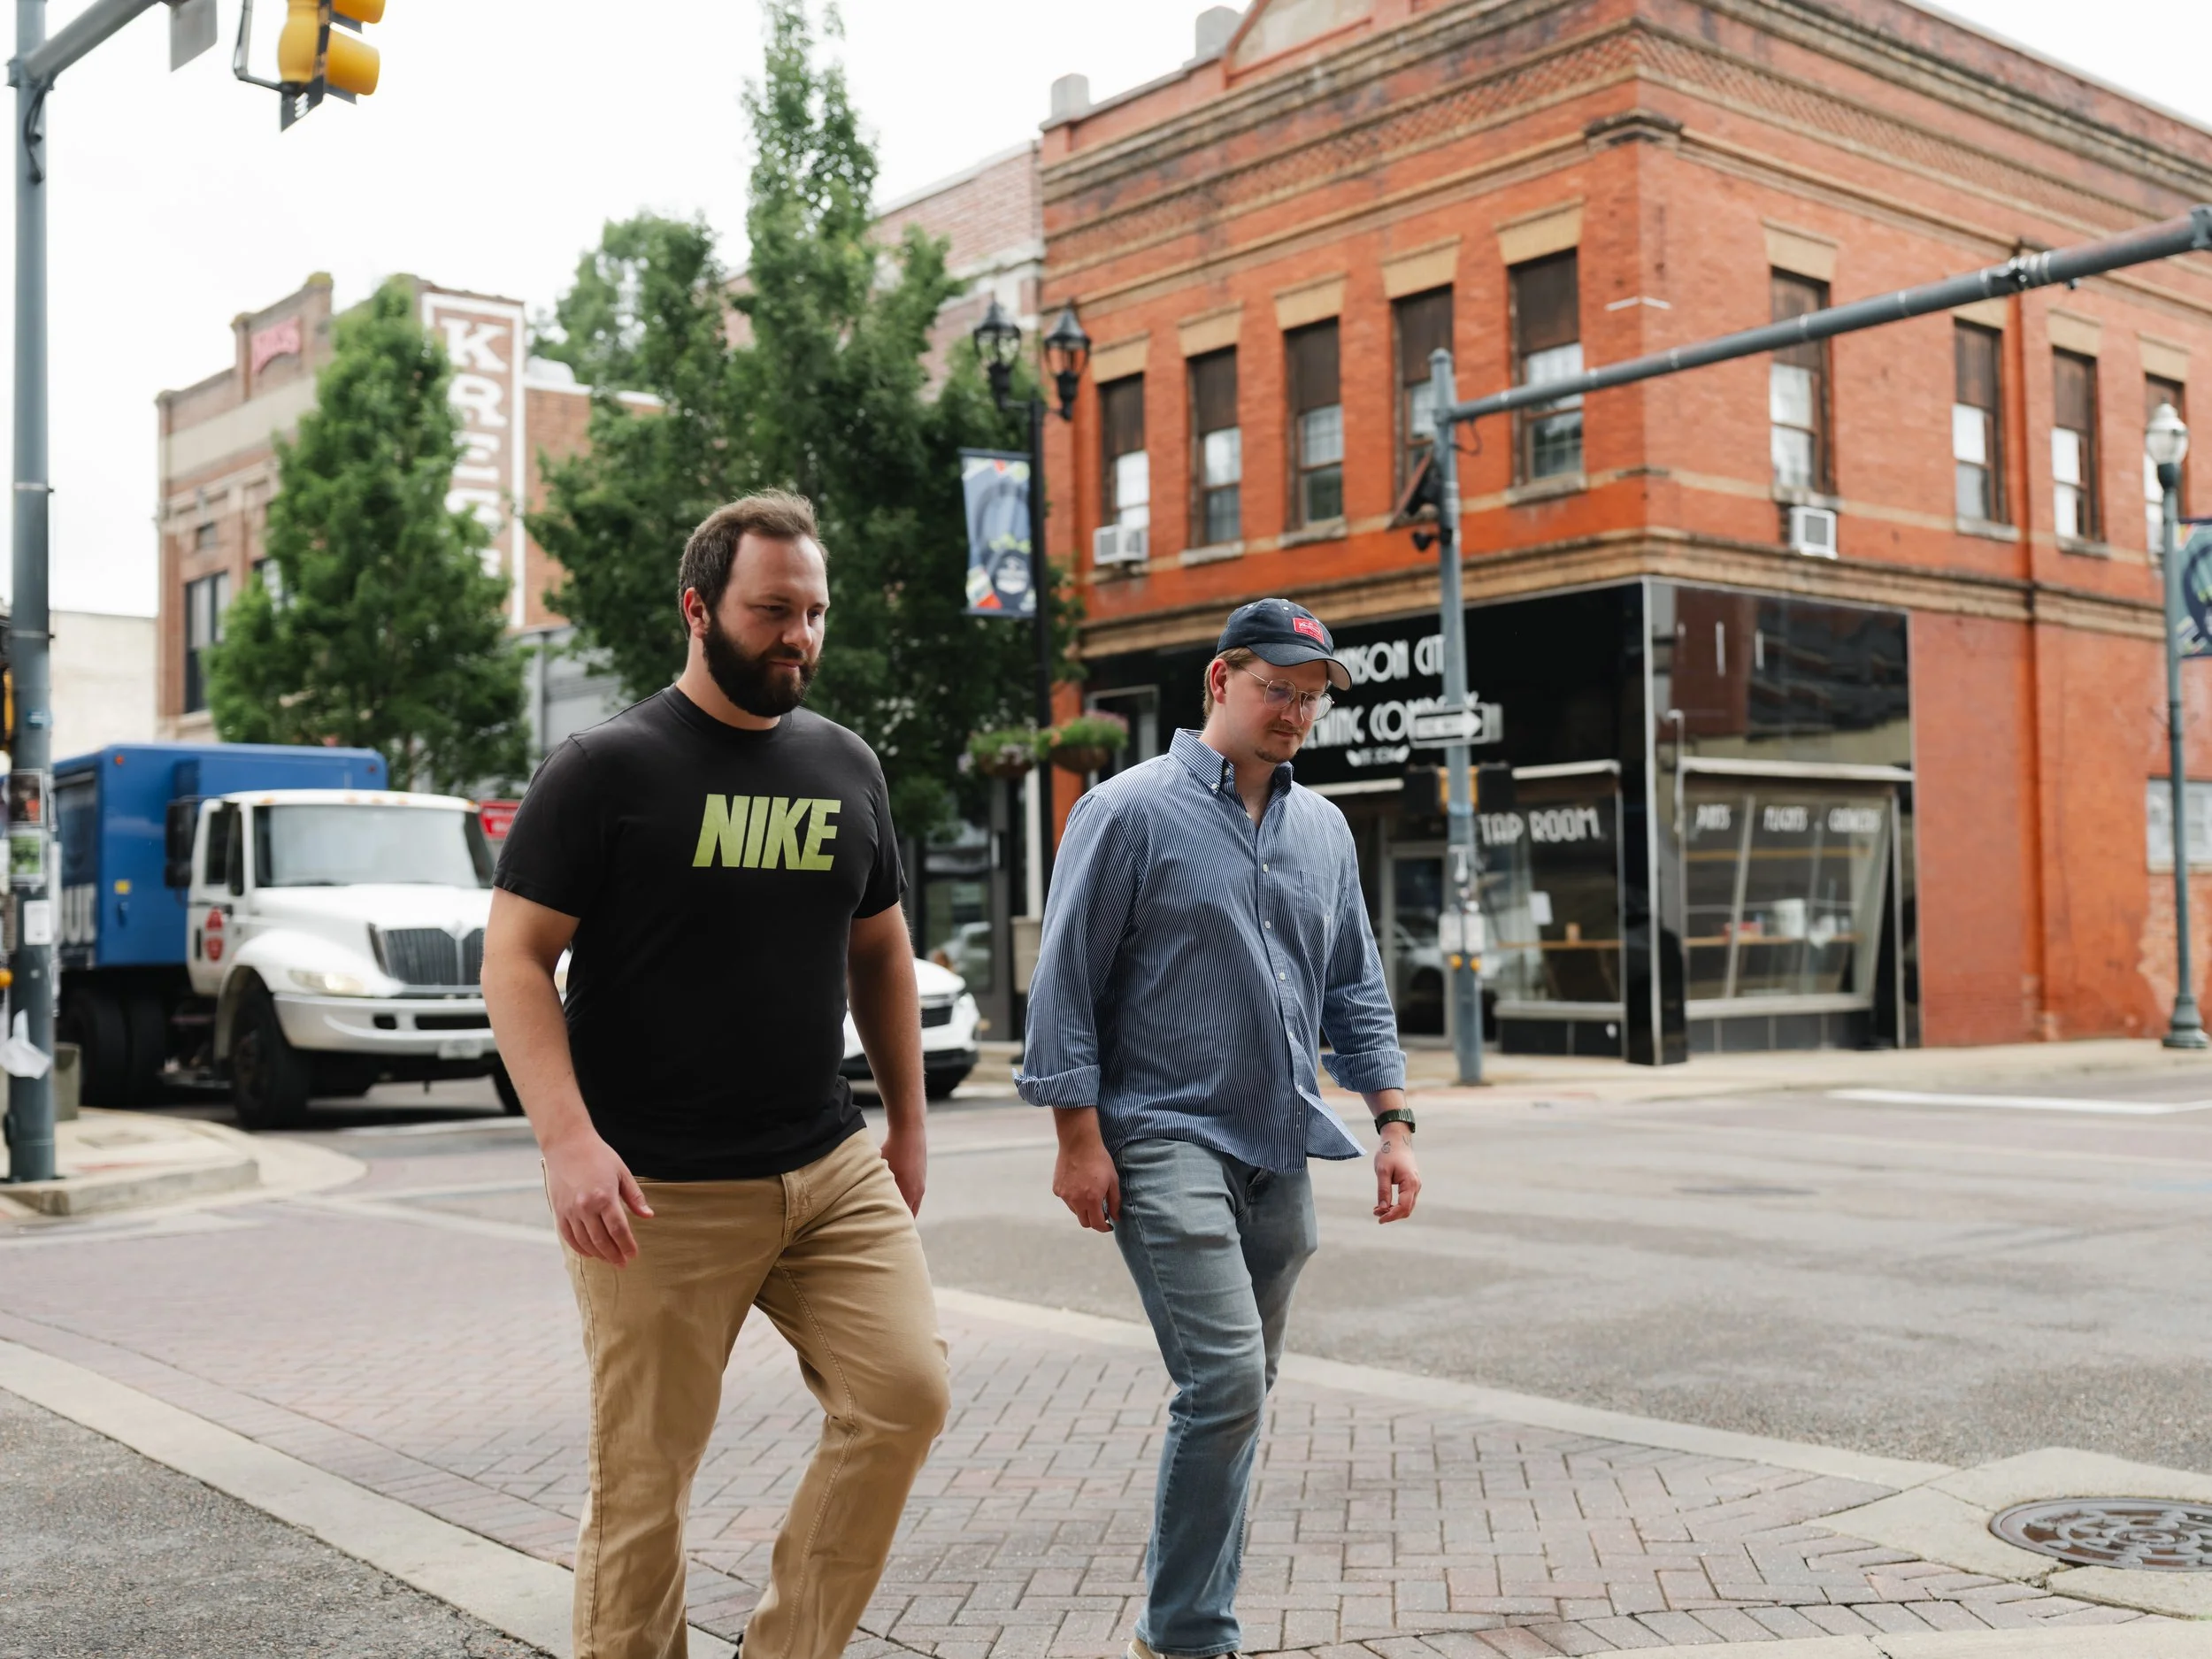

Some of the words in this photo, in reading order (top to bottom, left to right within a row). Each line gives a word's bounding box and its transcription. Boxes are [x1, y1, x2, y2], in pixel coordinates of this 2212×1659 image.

[692, 794, 841, 871] NIKE
[1479, 812, 1525, 846] TAP
[1528, 806, 1601, 843] ROOM
